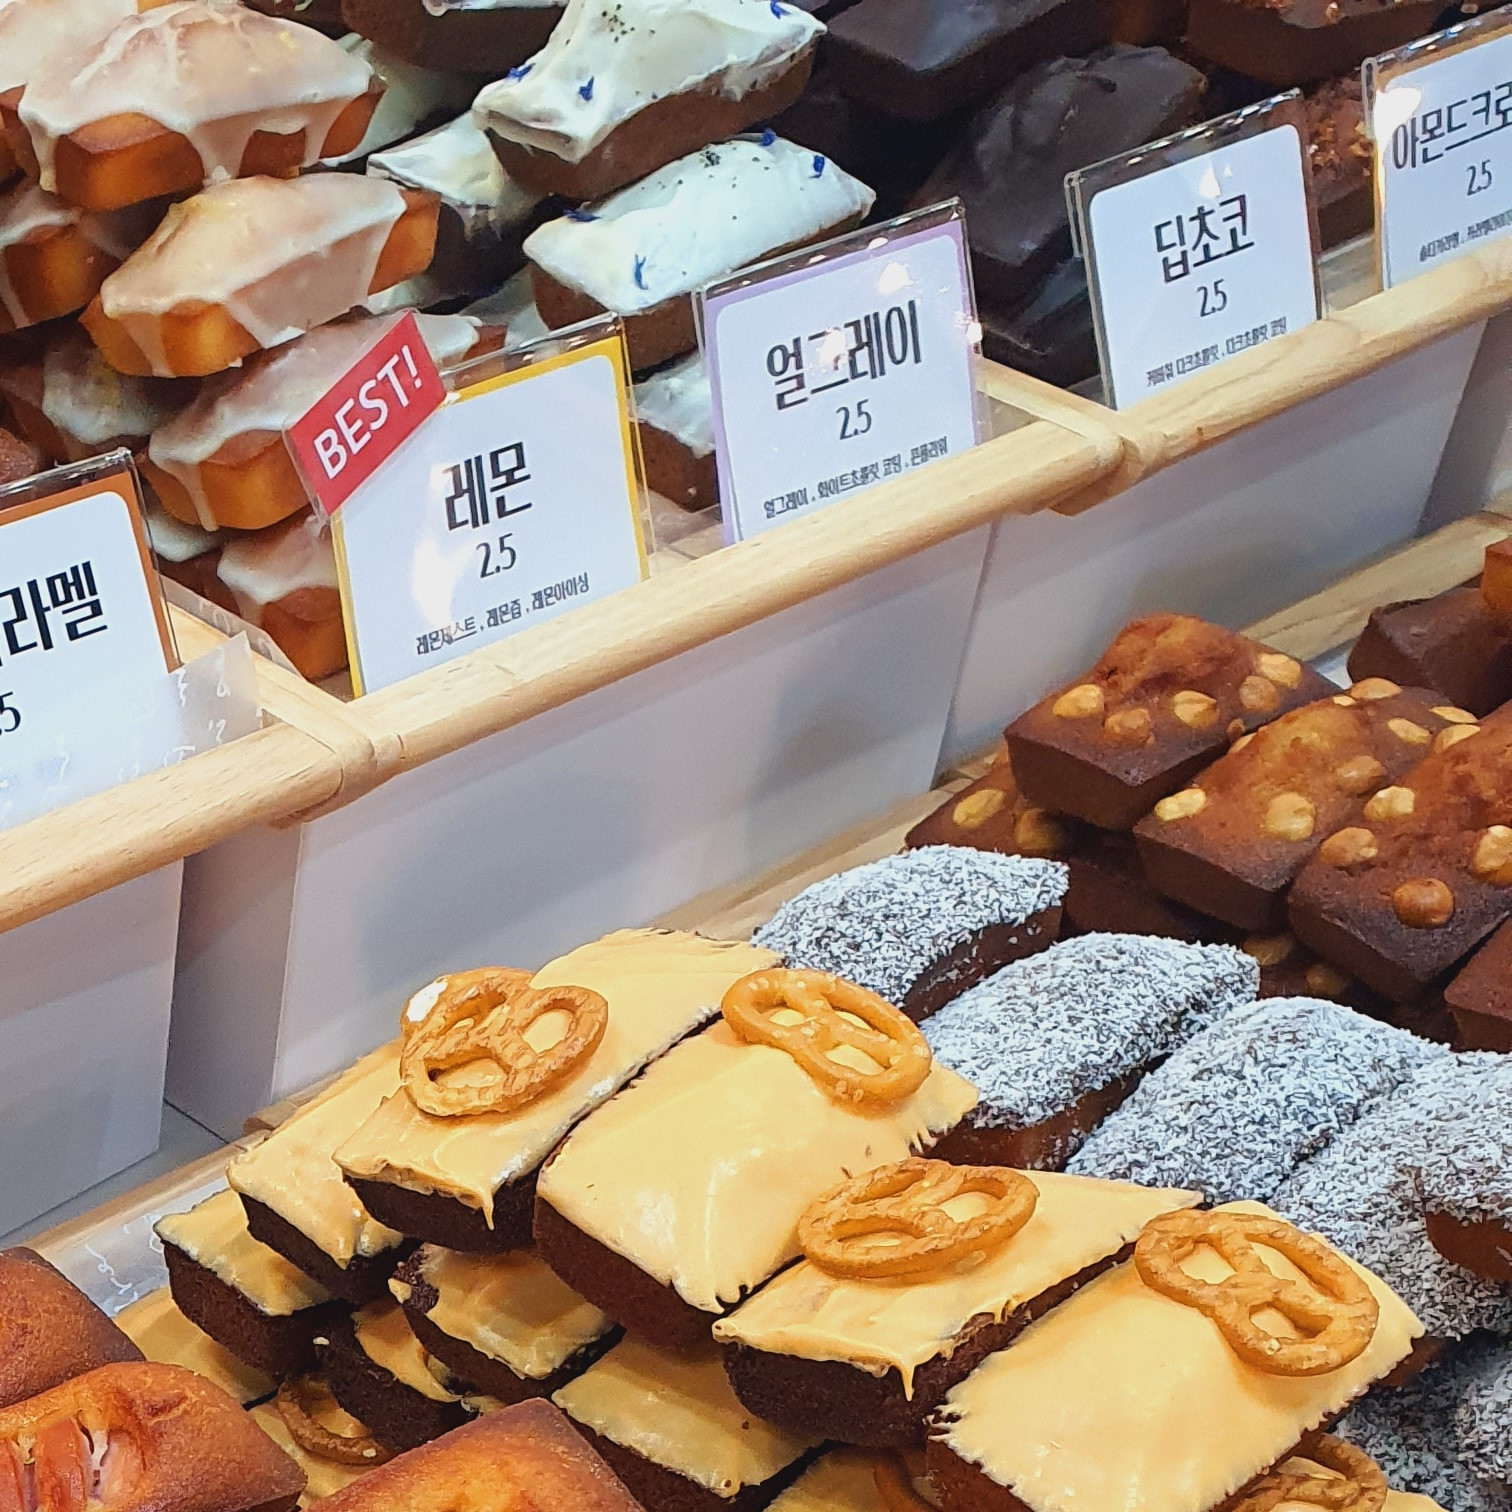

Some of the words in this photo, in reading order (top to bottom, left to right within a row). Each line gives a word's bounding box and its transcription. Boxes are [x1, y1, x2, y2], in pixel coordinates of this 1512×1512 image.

[1467, 159, 1493, 196] 2.5
[1154, 193, 1255, 284] 딥초코
[1196, 278, 1228, 317] 2.5
[766, 299, 922, 411] 얼그레이
[313, 345, 423, 480] BEST!
[836, 399, 872, 440] 2.5
[442, 441, 532, 531] 레몬
[475, 533, 517, 579] 2.5
[531, 572, 589, 610] 레몬아이싱
